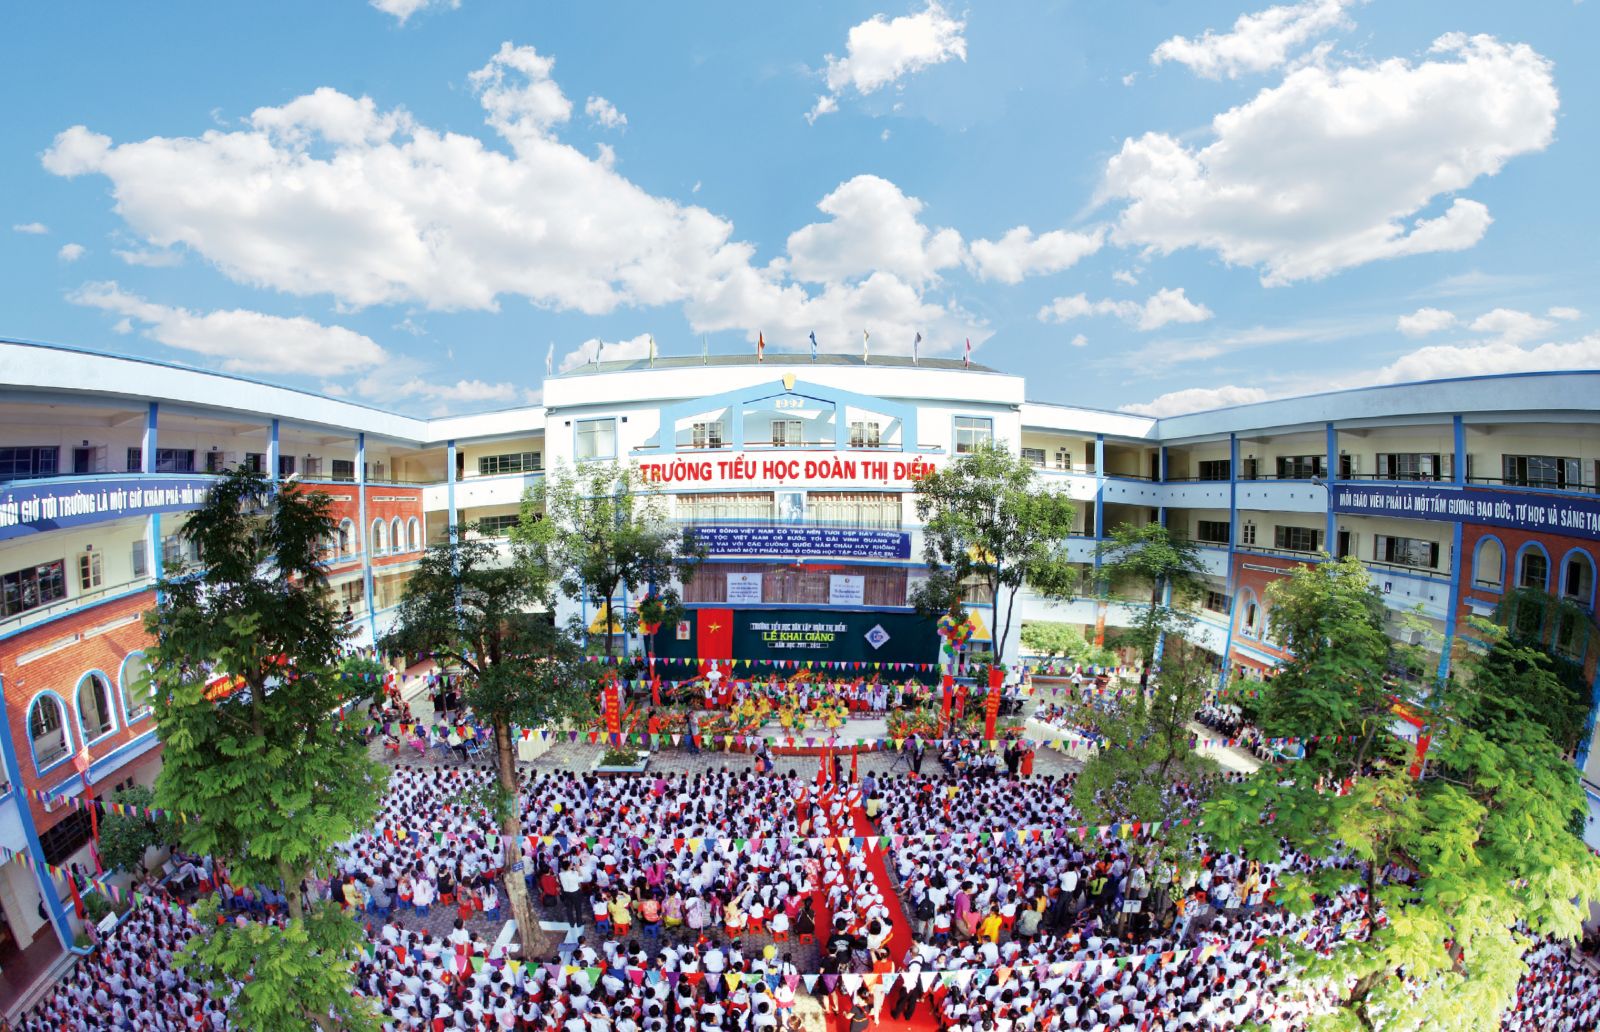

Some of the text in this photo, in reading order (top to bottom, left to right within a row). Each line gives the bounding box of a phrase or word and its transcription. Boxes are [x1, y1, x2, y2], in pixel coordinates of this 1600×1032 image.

[640, 454, 936, 485] TRƯỜNG TIỂU HỌC ĐOÀN THỊ ĐIỂM
[21, 494, 40, 523] GIỜ
[42, 493, 57, 519] TỚI
[59, 489, 96, 517] TRƯỜNG
[97, 488, 108, 512] LÀ
[110, 487, 127, 514] MỘT
[129, 486, 142, 509] GIỜ
[143, 485, 165, 507] KHÁM
[1339, 489, 1351, 506] MỖI
[1353, 491, 1367, 508] GIÁO
[1370, 492, 1384, 508] VIÊN
[1386, 490, 1402, 509] PHẢI
[1404, 493, 1412, 510] LÀ
[1414, 494, 1430, 515] MỘT
[1430, 494, 1447, 513] TẤM
[1448, 499, 1475, 516] GƯƠNG
[1477, 501, 1493, 521] ĐẠO
[1515, 504, 1527, 525] TỰ
[1528, 506, 1545, 526] HỌC
[1548, 504, 1558, 525] VÀ
[1560, 505, 1585, 529] SÁNG
[780, 632, 802, 641] KHAI
